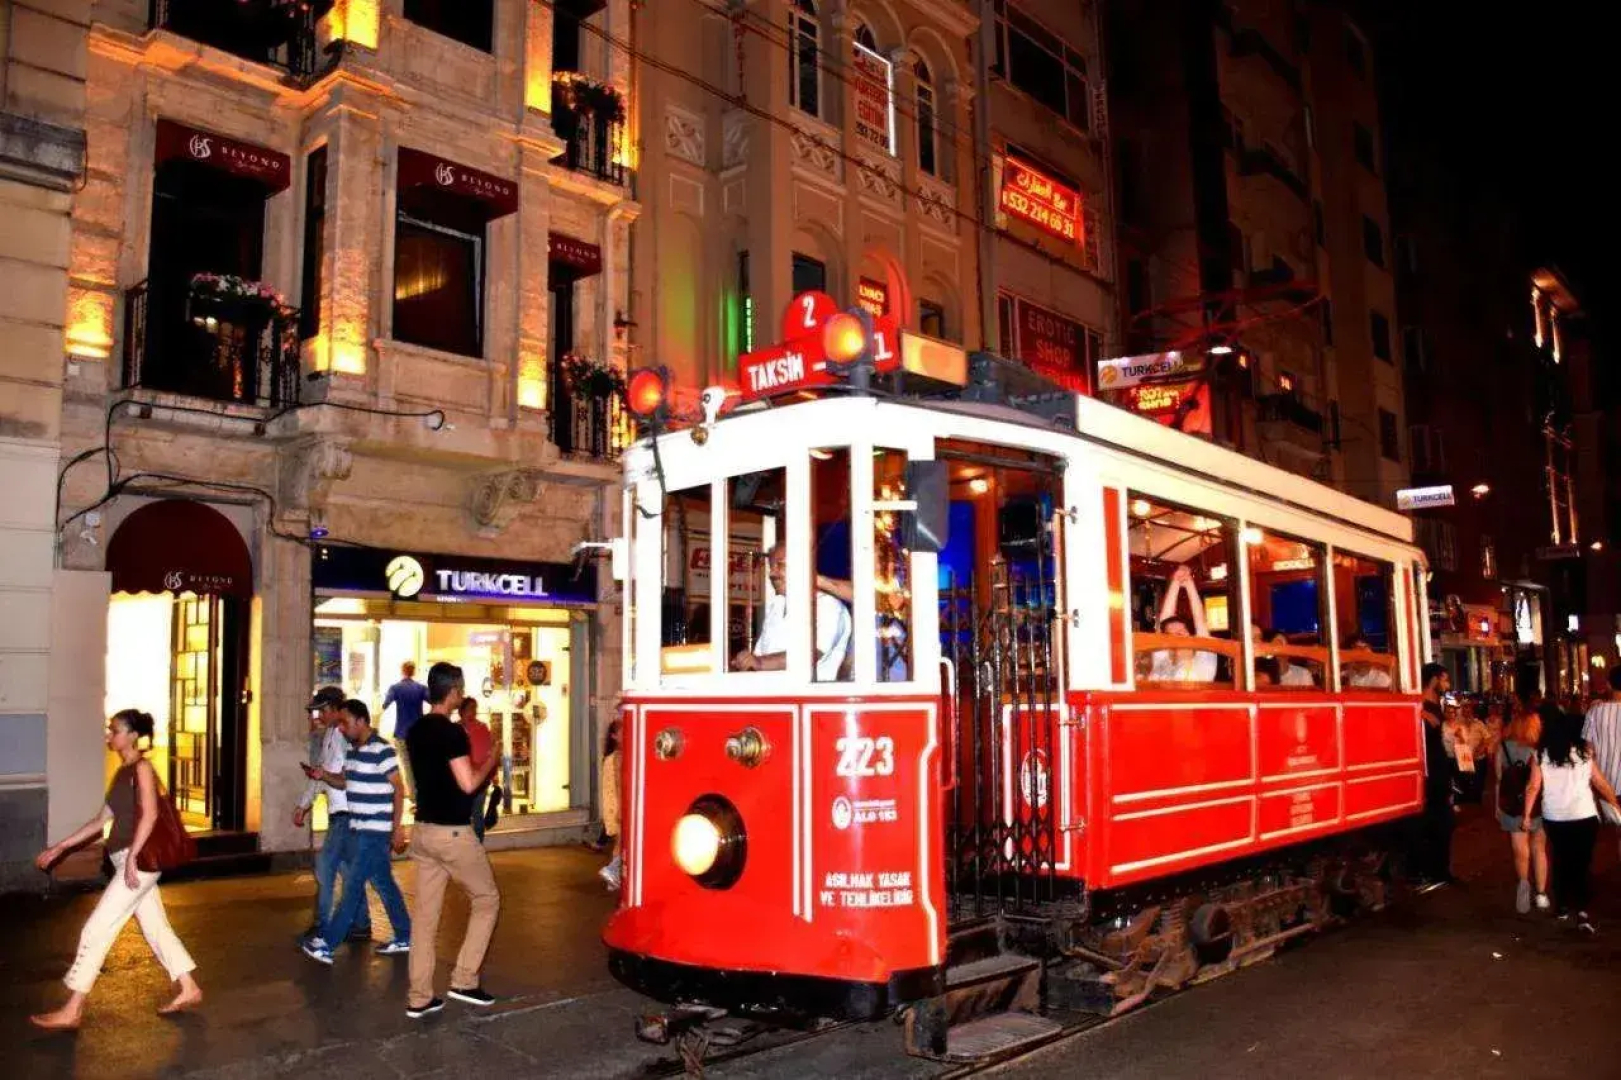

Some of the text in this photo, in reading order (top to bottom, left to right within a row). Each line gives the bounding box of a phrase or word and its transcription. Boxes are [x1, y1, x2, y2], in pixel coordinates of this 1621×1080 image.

[802, 295, 816, 328] 2
[1035, 338, 1071, 368] SHOP
[748, 351, 804, 391] TAKSİM
[436, 569, 549, 597] TURKCELL
[836, 736, 894, 776] 223
[878, 871, 911, 887] YASAK
[820, 891, 836, 906] VE
